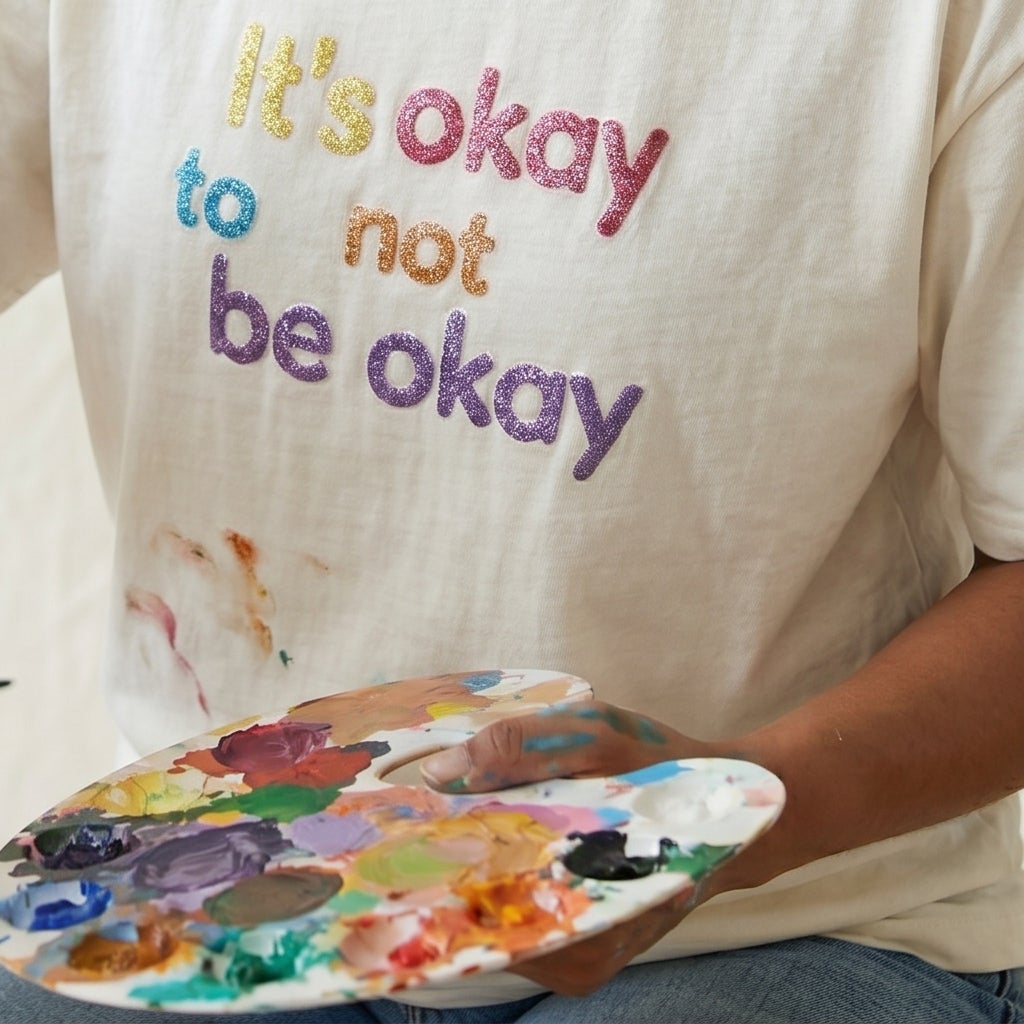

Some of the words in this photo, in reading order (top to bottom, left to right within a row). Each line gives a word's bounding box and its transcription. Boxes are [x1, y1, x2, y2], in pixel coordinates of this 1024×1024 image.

[176, 146, 257, 240] to
[344, 204, 495, 296] not
[227, 23, 375, 155] It's
[396, 67, 669, 237] okay
[210, 253, 333, 383] be
[367, 308, 644, 481] okay
